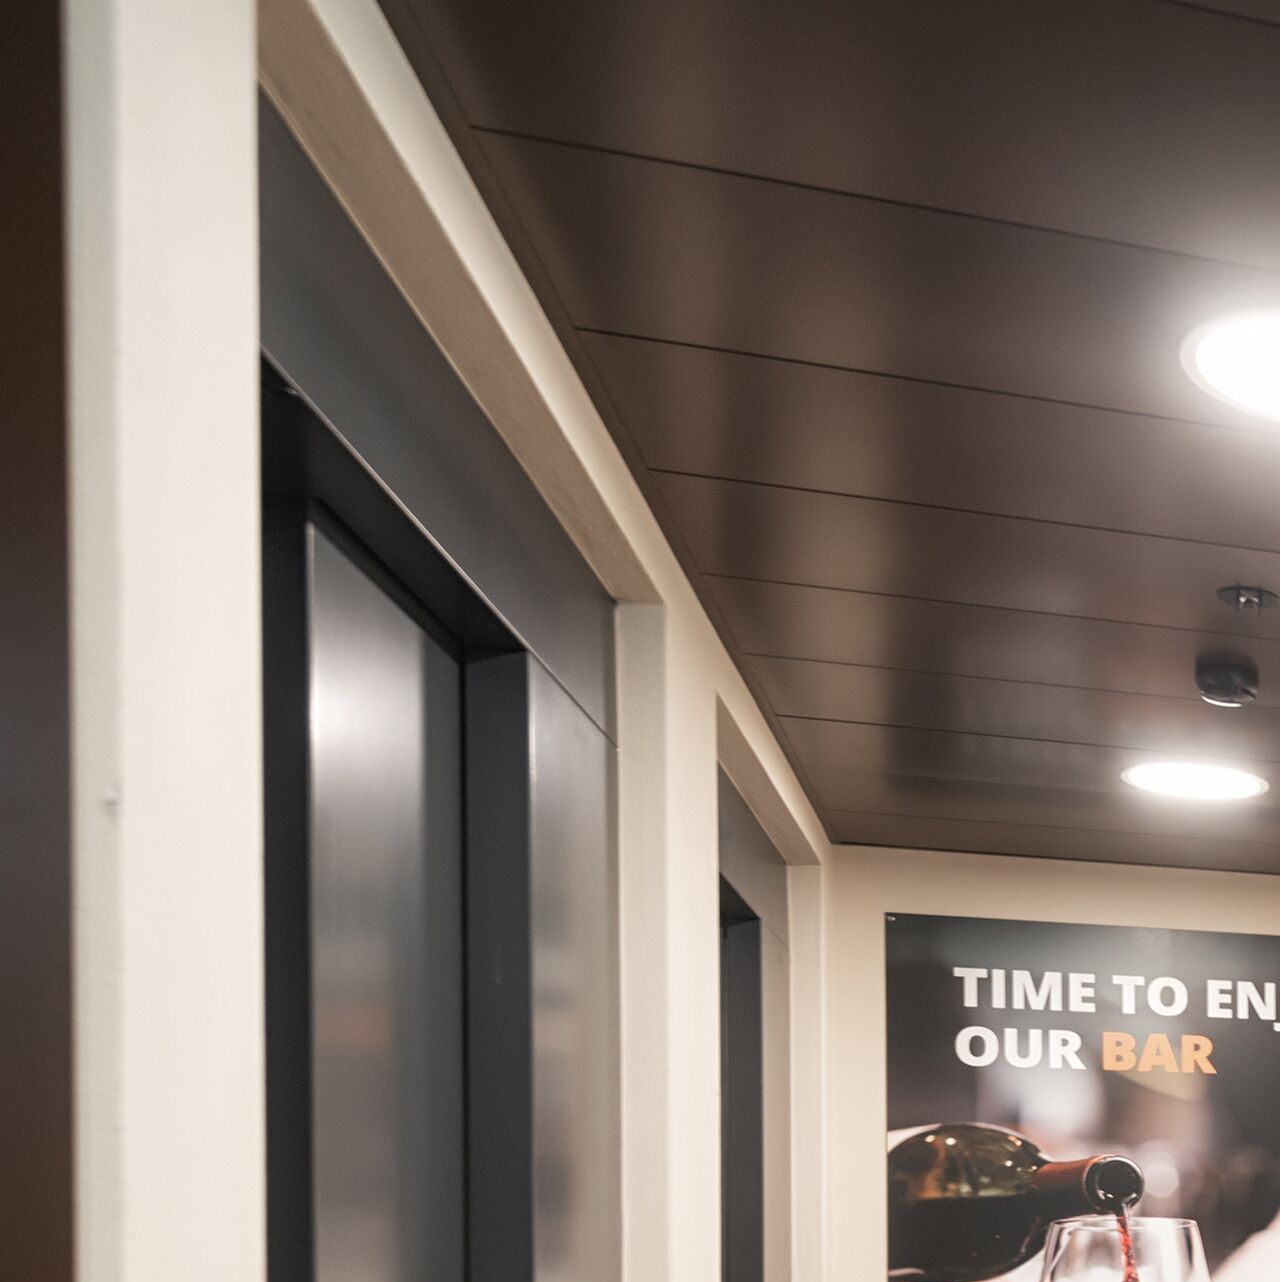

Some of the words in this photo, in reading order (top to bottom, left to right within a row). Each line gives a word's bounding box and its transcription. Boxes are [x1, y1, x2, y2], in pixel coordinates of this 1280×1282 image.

[954, 966, 1096, 1013] TIME
[1112, 974, 1188, 1017] TO
[954, 1026, 1087, 1071] OUR
[1102, 1031, 1217, 1075] BAR
